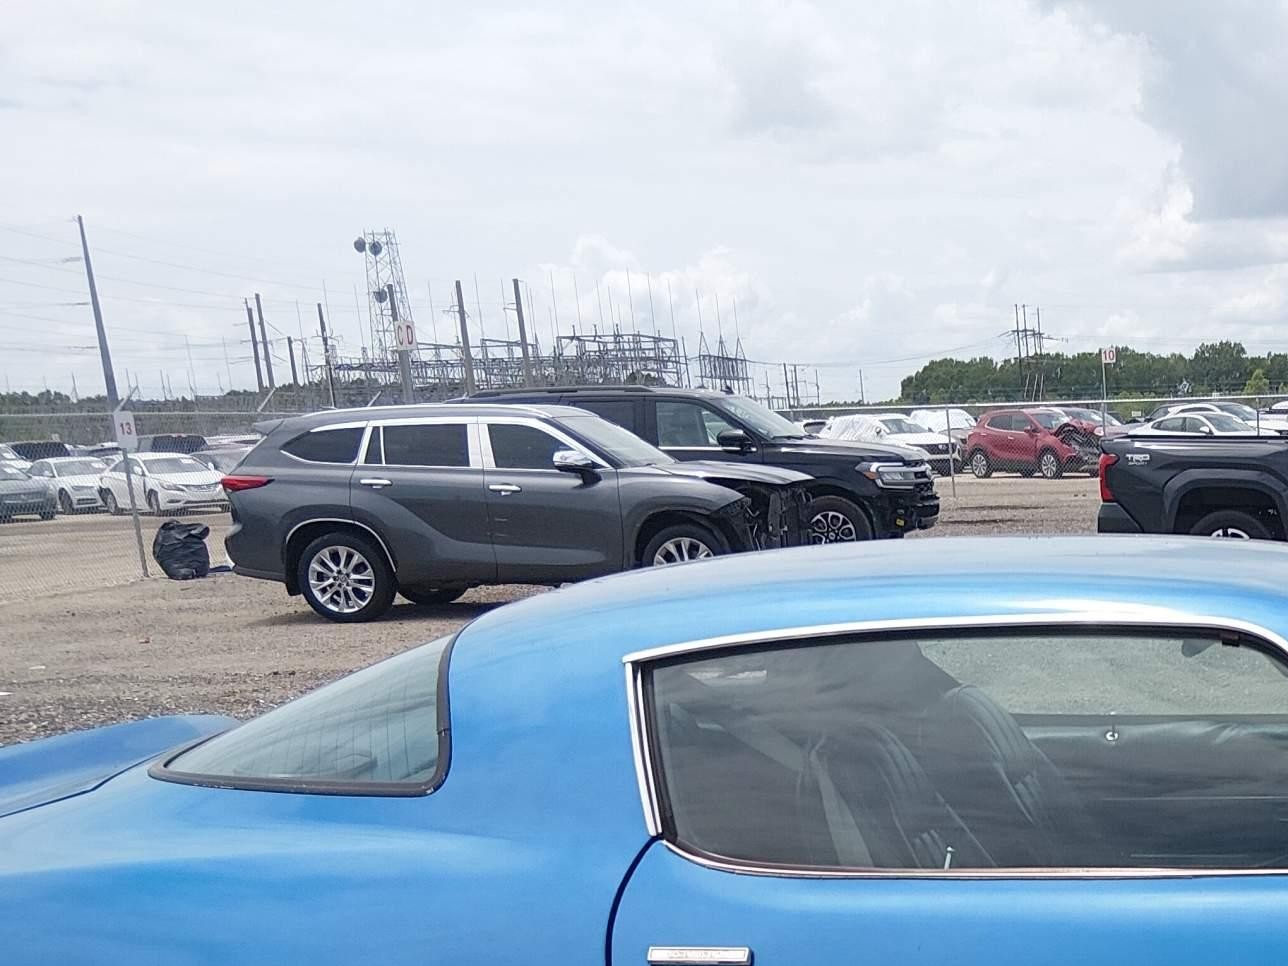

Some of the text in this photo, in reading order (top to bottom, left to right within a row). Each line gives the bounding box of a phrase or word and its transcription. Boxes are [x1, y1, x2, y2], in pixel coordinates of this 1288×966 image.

[397, 324, 414, 346] C D
[1103, 350, 1115, 361] 10
[120, 422, 132, 435] 13
[1125, 453, 1151, 463] TRD
